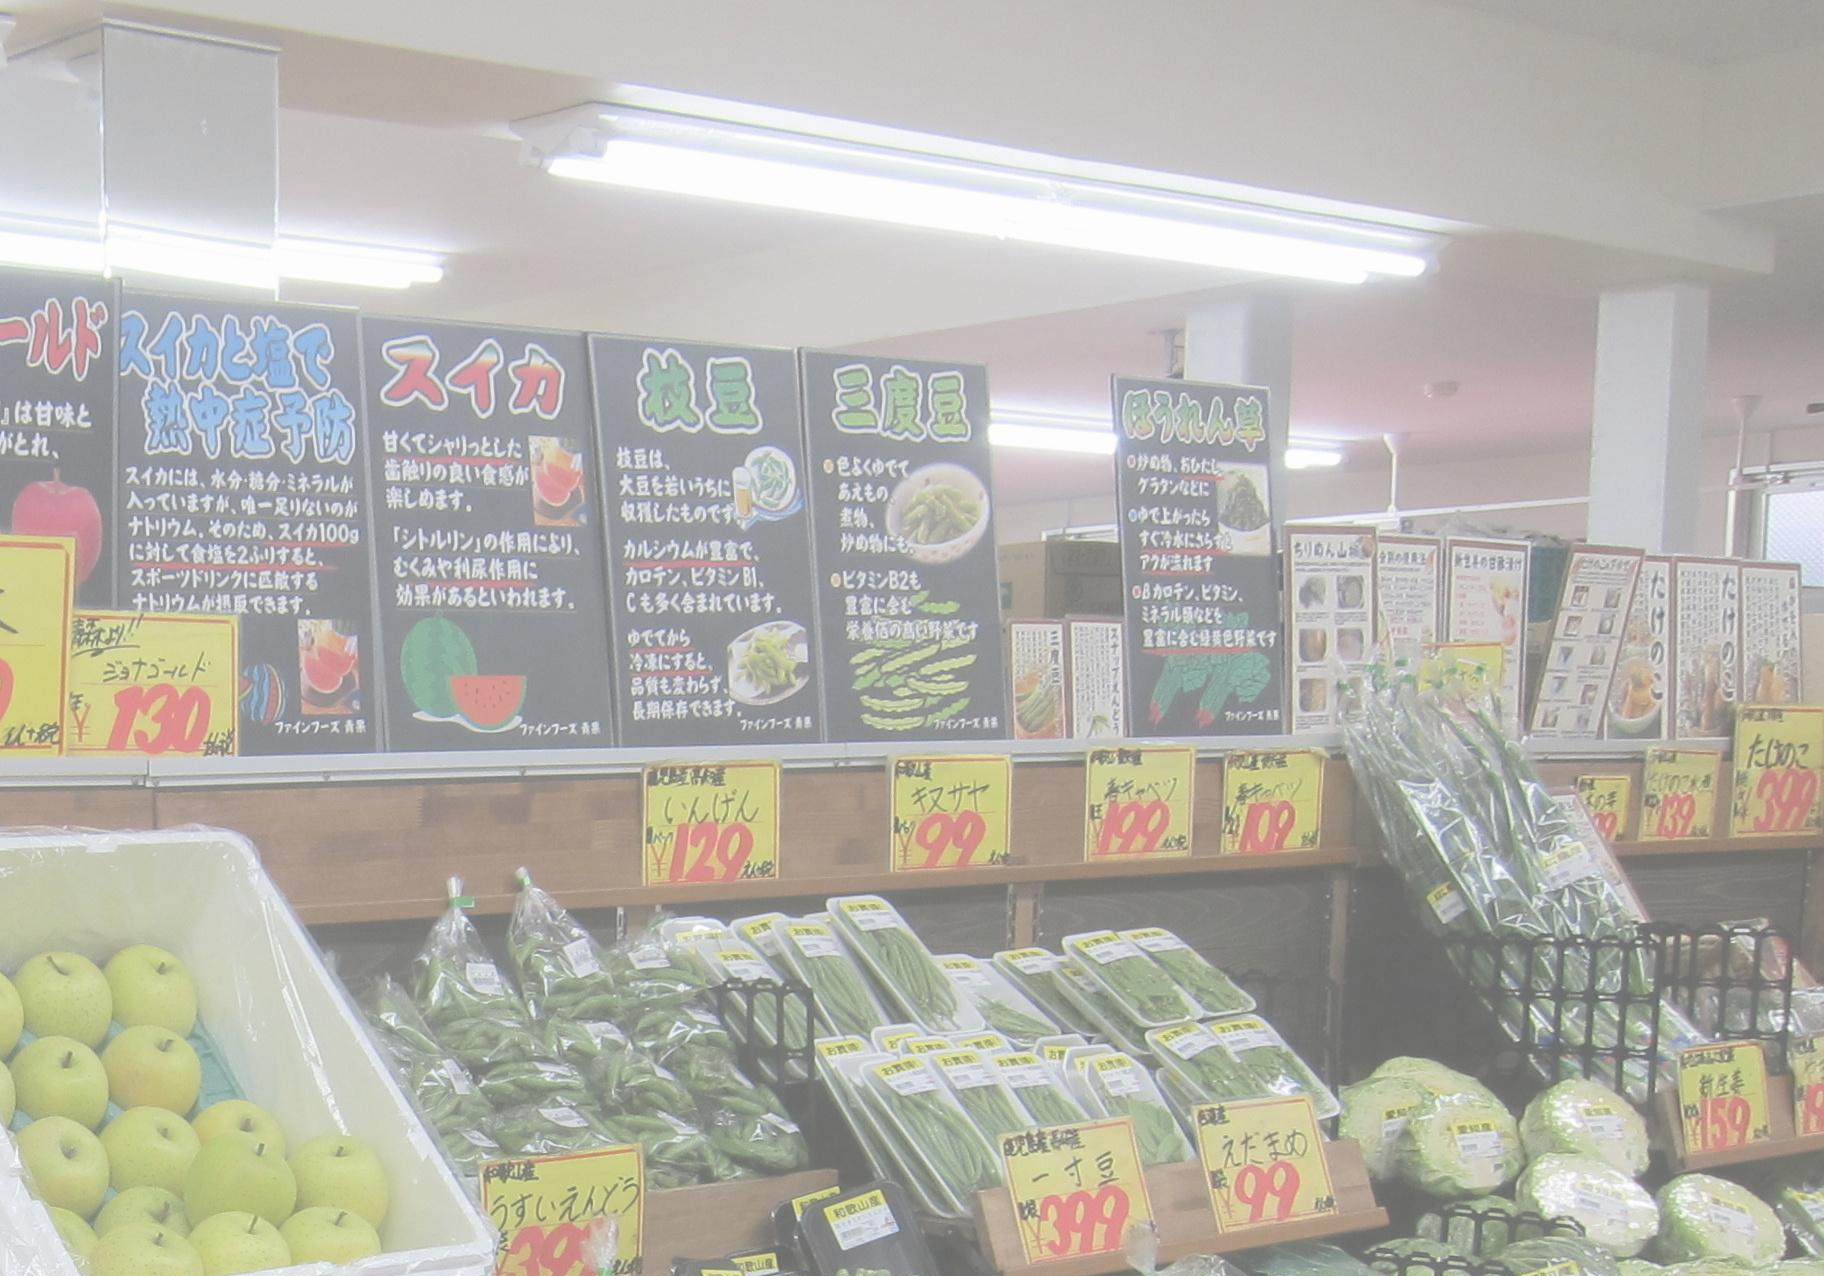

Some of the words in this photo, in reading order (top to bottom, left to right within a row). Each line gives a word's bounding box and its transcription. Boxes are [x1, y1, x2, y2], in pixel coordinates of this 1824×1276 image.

[120, 310, 335, 391] スイカと塩で
[380, 334, 565, 420] スイカ
[636, 347, 764, 434] 枝豆
[832, 363, 972, 444] 三度豆
[141, 376, 356, 464] 熱中症予防
[1122, 389, 1266, 452] ほうれん草
[382, 430, 523, 457] 甘くてシャリっとした
[616, 446, 670, 471] 枝豆は、
[836, 456, 910, 479] 色よくゆでて
[385, 459, 530, 486] 歯触りの良い食感が
[619, 473, 732, 498] 大豆を若いうちに
[126, 490, 358, 518] 入っていますが、唯一足りないのが
[386, 486, 472, 512] 楽しめます。
[839, 507, 875, 529] 煮物、
[1138, 506, 1212, 527] ゆで上がったら
[623, 539, 759, 561] カルシウムが豊富で、
[131, 568, 319, 591] スポーツドリンクに匹敵する
[393, 556, 538, 580] むくみや利尿作用に
[842, 571, 922, 591] ビタミンB2も
[395, 583, 575, 610] 効果があるといわれます。
[844, 594, 913, 616] 豊富に含む
[628, 628, 691, 647] ゆでてから
[1650, 571, 1666, 700] たけのこ
[1720, 571, 1736, 700] たけのこ
[629, 653, 713, 672] 冷凍にすると、
[630, 676, 728, 697] 品質も変わらず、
[632, 700, 742, 721] 長期保存できます。
[663, 789, 760, 825] いんげん
[910, 780, 991, 814] キヌサヤ
[1221, 1130, 1309, 1170] えだまめ
[1031, 1150, 1120, 1188] 一寸豆
[490, 1177, 640, 1232] うすいえんどう
[832, 1194, 880, 1220] 和歌山産
